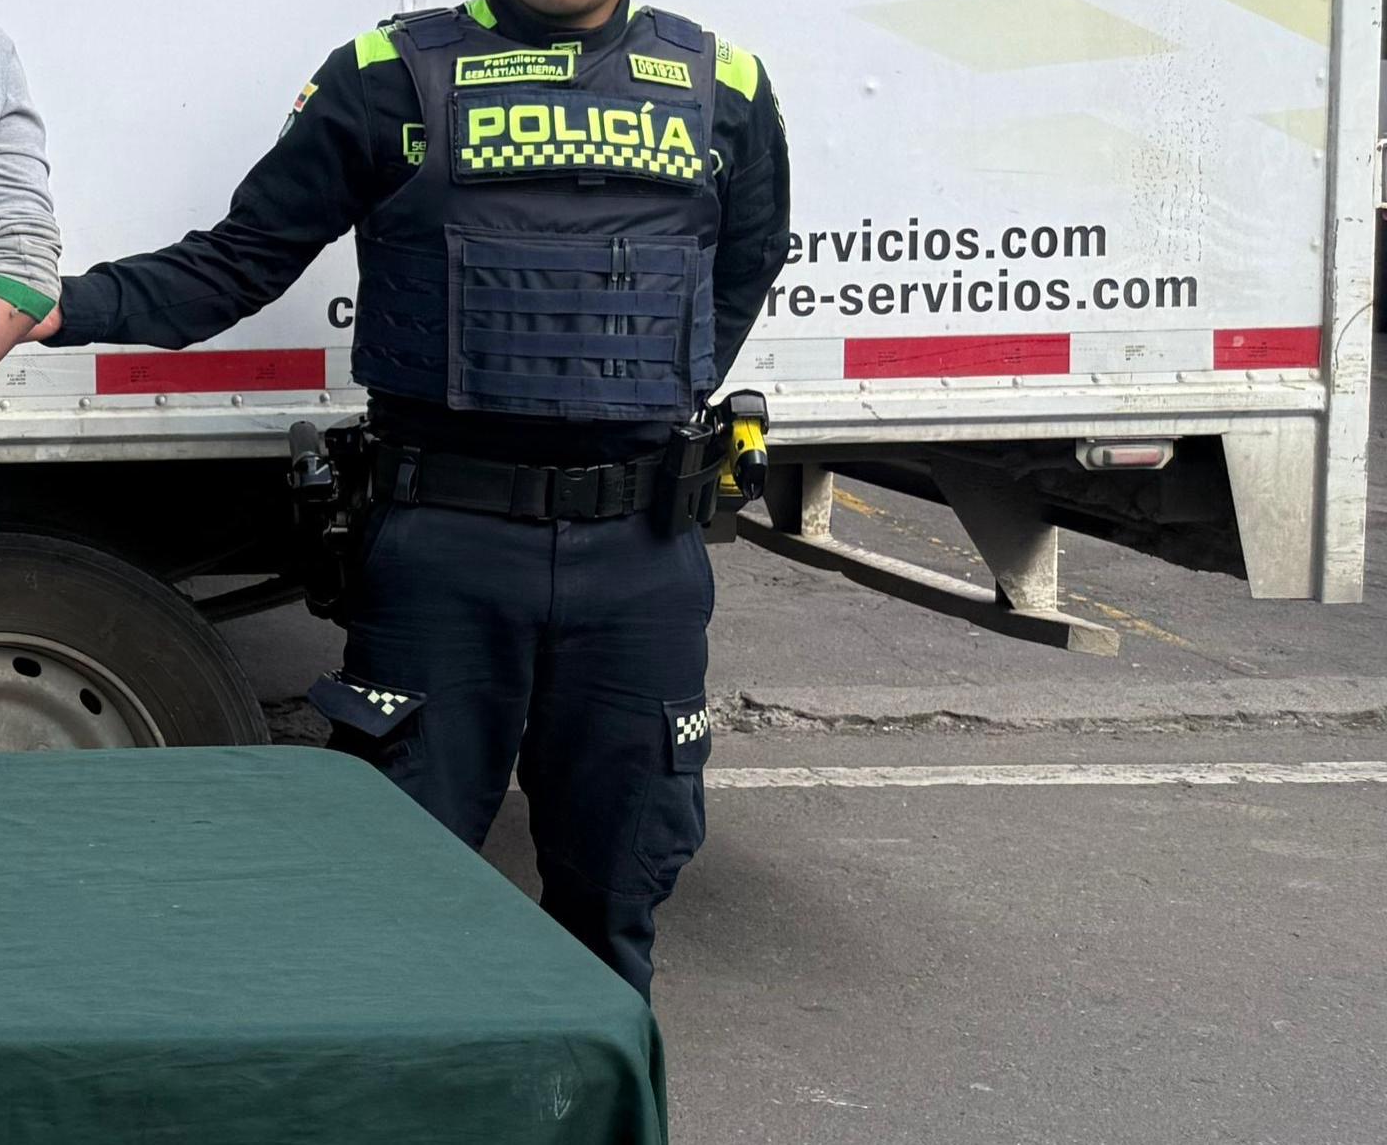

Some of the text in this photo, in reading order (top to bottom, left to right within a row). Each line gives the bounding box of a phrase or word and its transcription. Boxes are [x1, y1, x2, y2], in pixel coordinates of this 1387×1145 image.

[484, 55, 546, 67] Patrullero
[465, 64, 564, 79] SEBASTIAN SIERRA
[468, 101, 697, 156] POLICÍA
